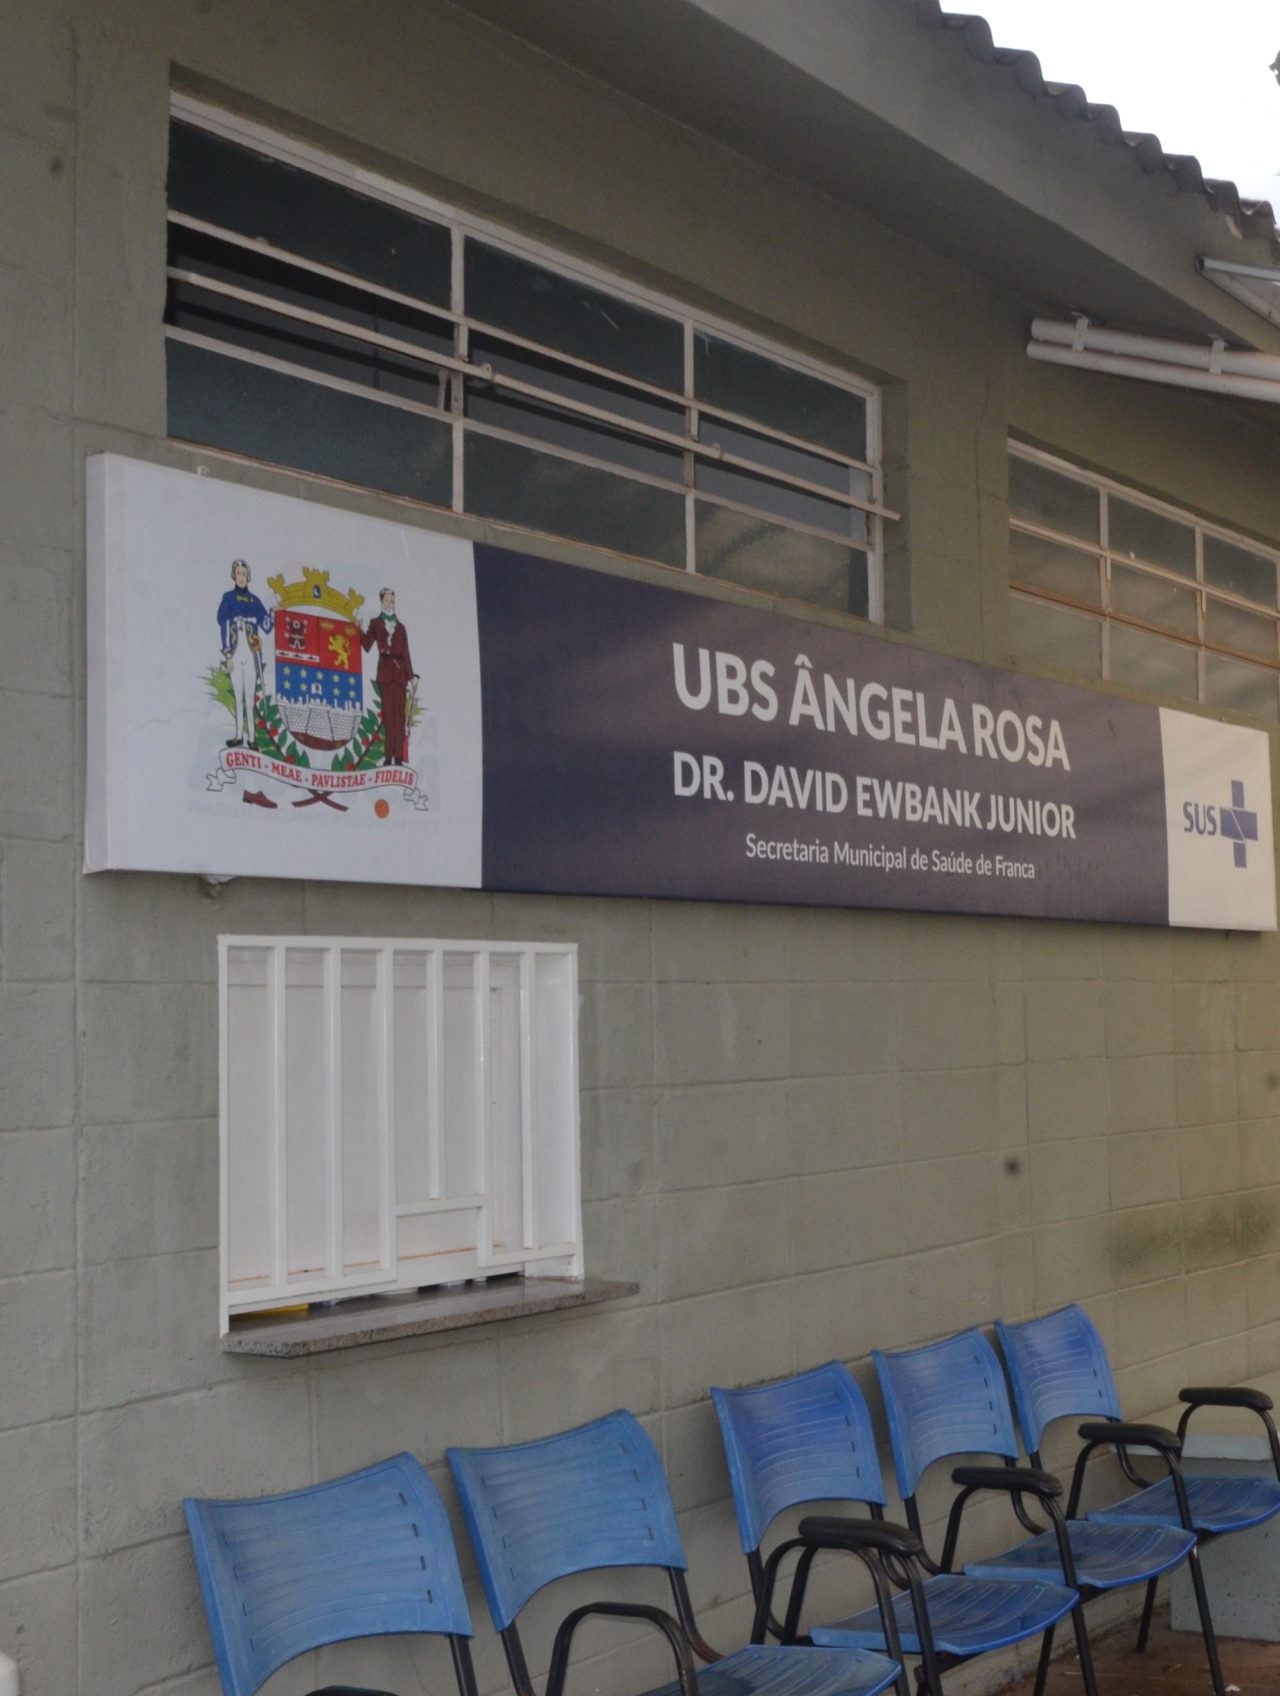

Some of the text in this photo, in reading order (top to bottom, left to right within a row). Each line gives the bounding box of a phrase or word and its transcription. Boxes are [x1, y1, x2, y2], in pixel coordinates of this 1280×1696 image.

[673, 642, 1071, 771] UBS ÂNGELA ROSA
[226, 751, 414, 789] GENTI MEAE PAVLISTAE FIDELIS
[673, 751, 1077, 840] DR. DAVID EWBANK JUNIOR
[1182, 801, 1217, 836] SUS
[745, 833, 1035, 879] Secretaria Municipal de Saúde de Franca
